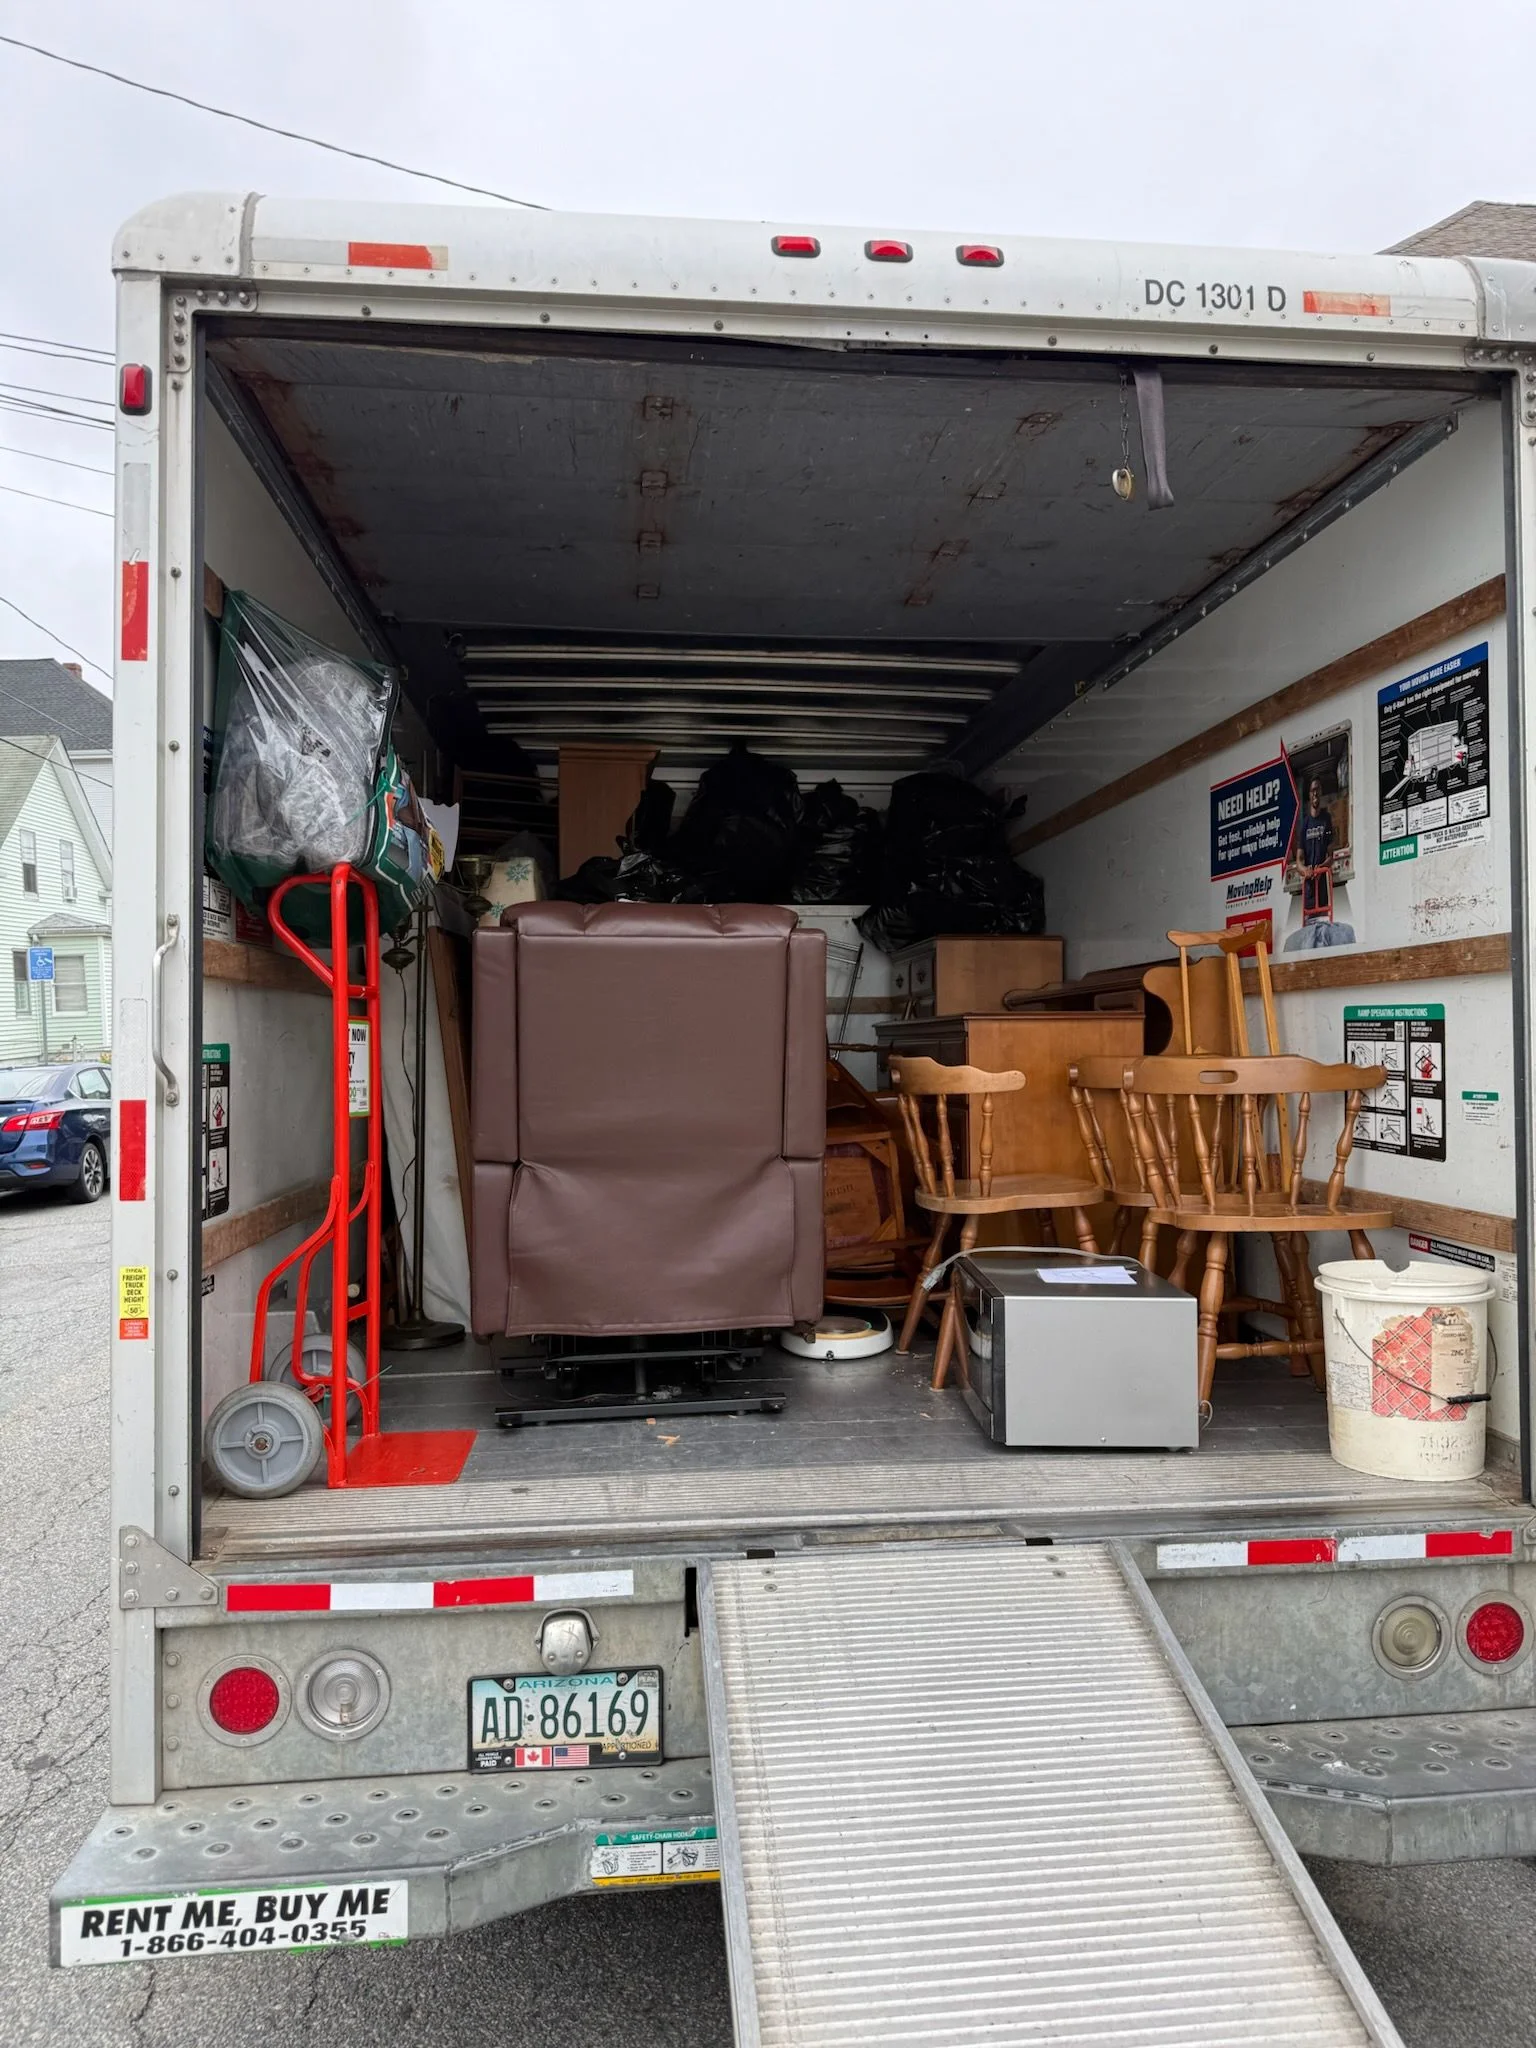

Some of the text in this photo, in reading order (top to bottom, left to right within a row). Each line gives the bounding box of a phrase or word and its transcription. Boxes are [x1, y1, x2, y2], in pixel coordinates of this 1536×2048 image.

[1145, 279, 1287, 312] DC 1301 D
[1218, 778, 1280, 822] NEED HELP?
[1218, 834, 1228, 847] Get
[1242, 821, 1266, 839] reliable
[1266, 816, 1280, 831] help
[1218, 849, 1227, 861] for
[1227, 847, 1241, 861] your
[1258, 832, 1279, 850] today!
[1382, 843, 1415, 860] ATTENTION
[1226, 876, 1273, 900] MovingHelp
[352, 1028, 367, 1042] NOW
[124, 1296, 144, 1304] HEIGHT
[519, 1676, 614, 1689] ARIZONA
[480, 1760, 497, 1768] PAID
[631, 1832, 672, 1841] SAFETY-CHAIN
[80, 1888, 391, 1939] RENT ME, BUY ME
[120, 1919, 367, 1957] 1-866-404-0355
